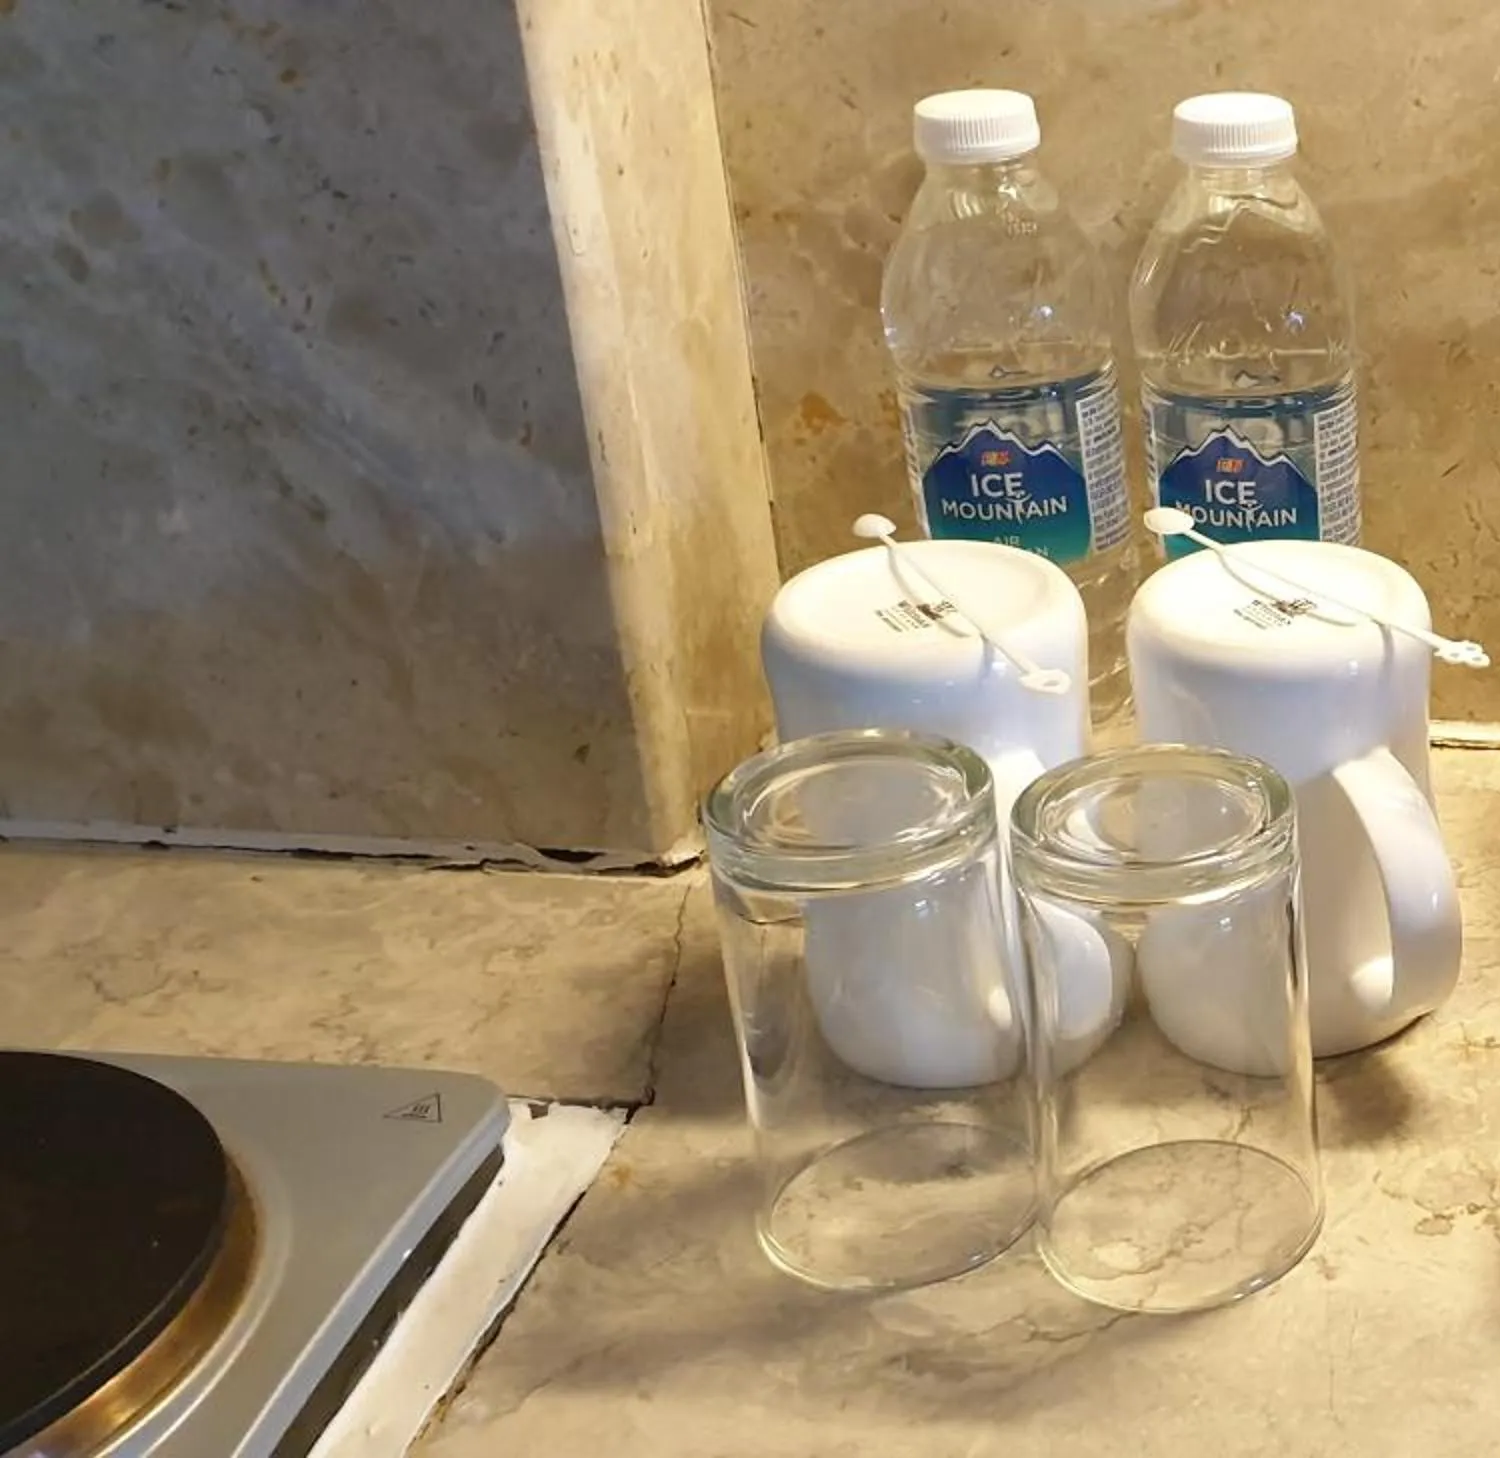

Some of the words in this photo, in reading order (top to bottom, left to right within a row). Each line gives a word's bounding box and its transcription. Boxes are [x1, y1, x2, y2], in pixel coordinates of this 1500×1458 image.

[971, 472, 1024, 497] ICE
[1205, 479, 1258, 505] ICE
[941, 496, 1068, 524] MOUNTAIN
